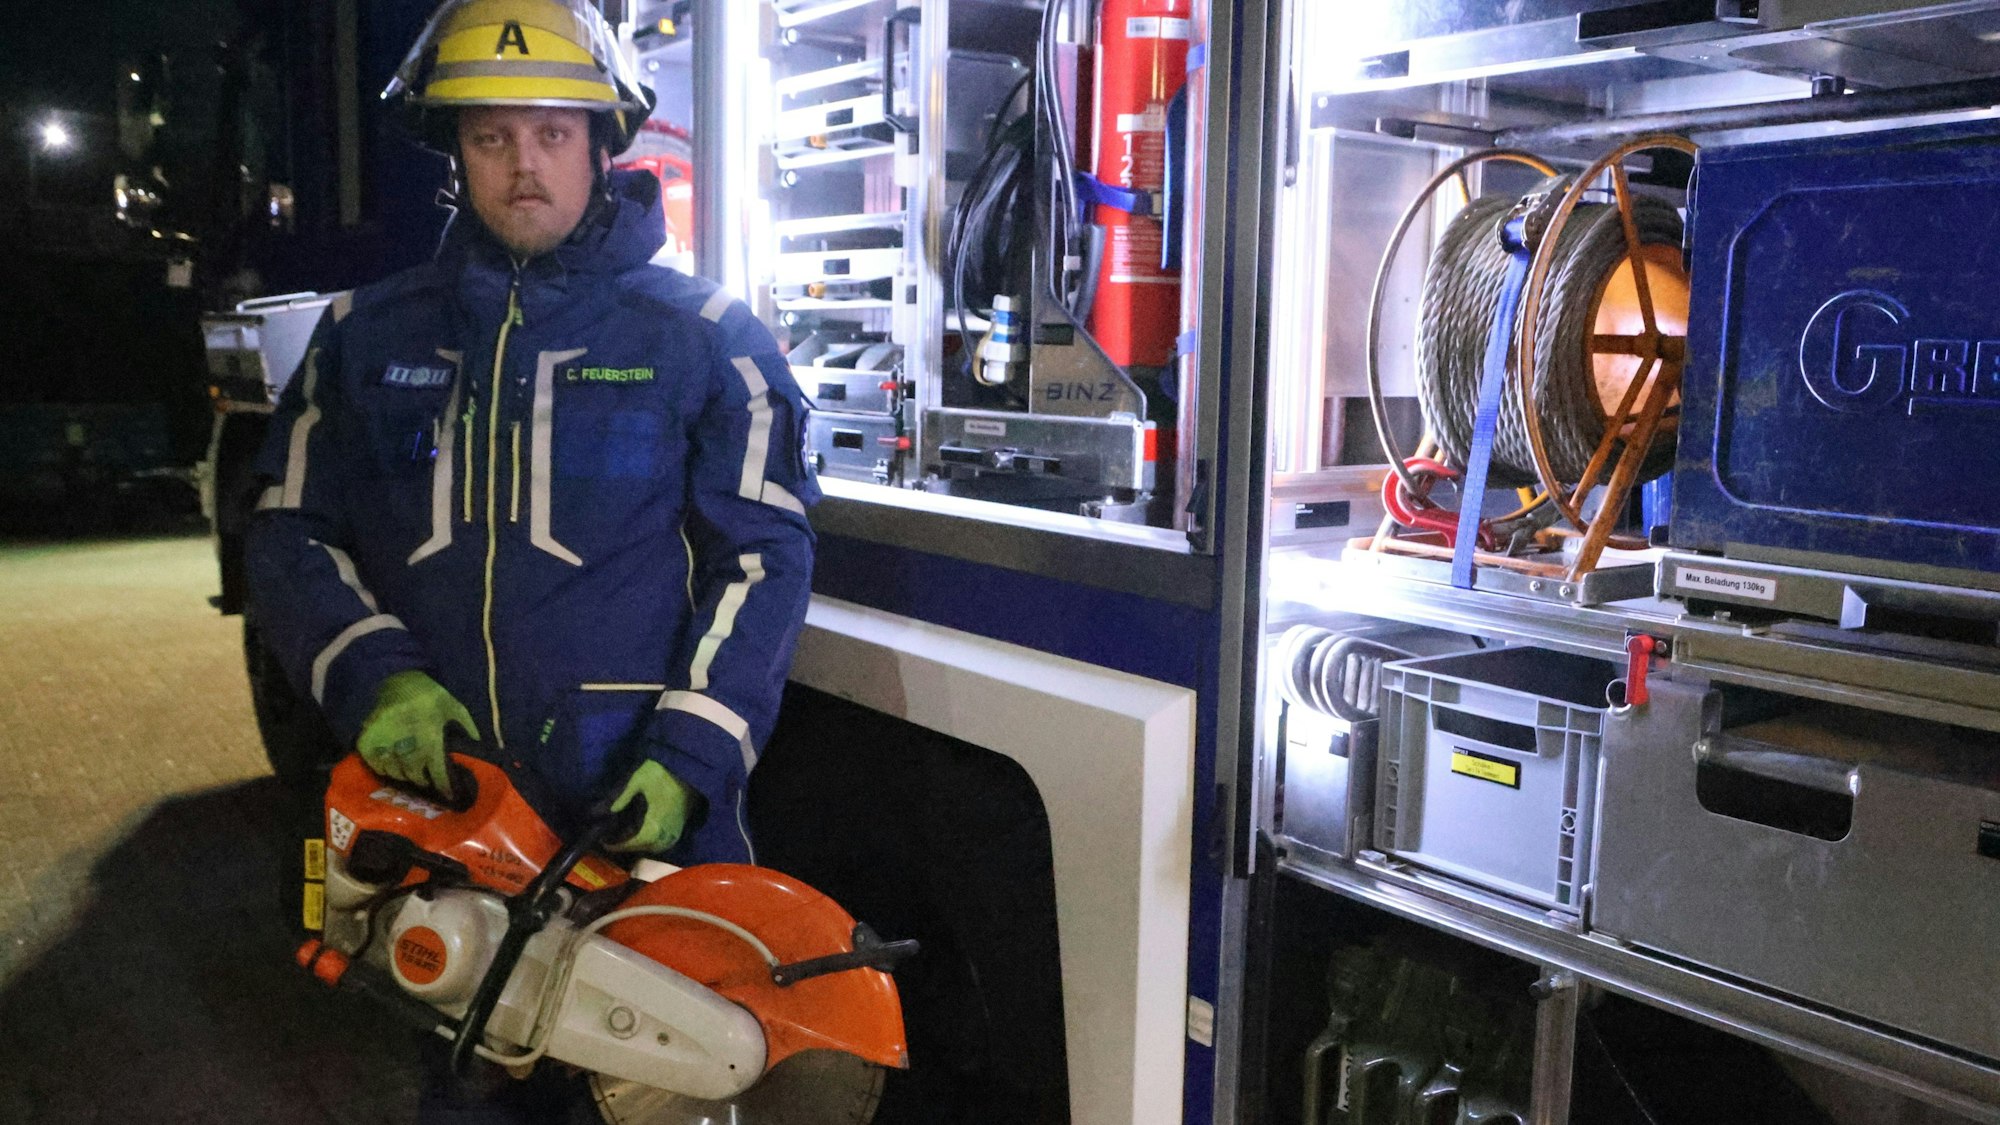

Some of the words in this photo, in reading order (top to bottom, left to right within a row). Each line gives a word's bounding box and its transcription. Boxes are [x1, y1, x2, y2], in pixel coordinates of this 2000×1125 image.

[495, 19, 529, 55] A
[1123, 133, 1132, 155] 1
[1120, 155, 1133, 178] 2
[581, 367, 654, 381] FEUERSTEIN
[1047, 382, 1116, 401] BINZ
[1686, 573, 1702, 583] Max.
[1704, 575, 1740, 590] Beladung
[1743, 581, 1765, 593] 130kg
